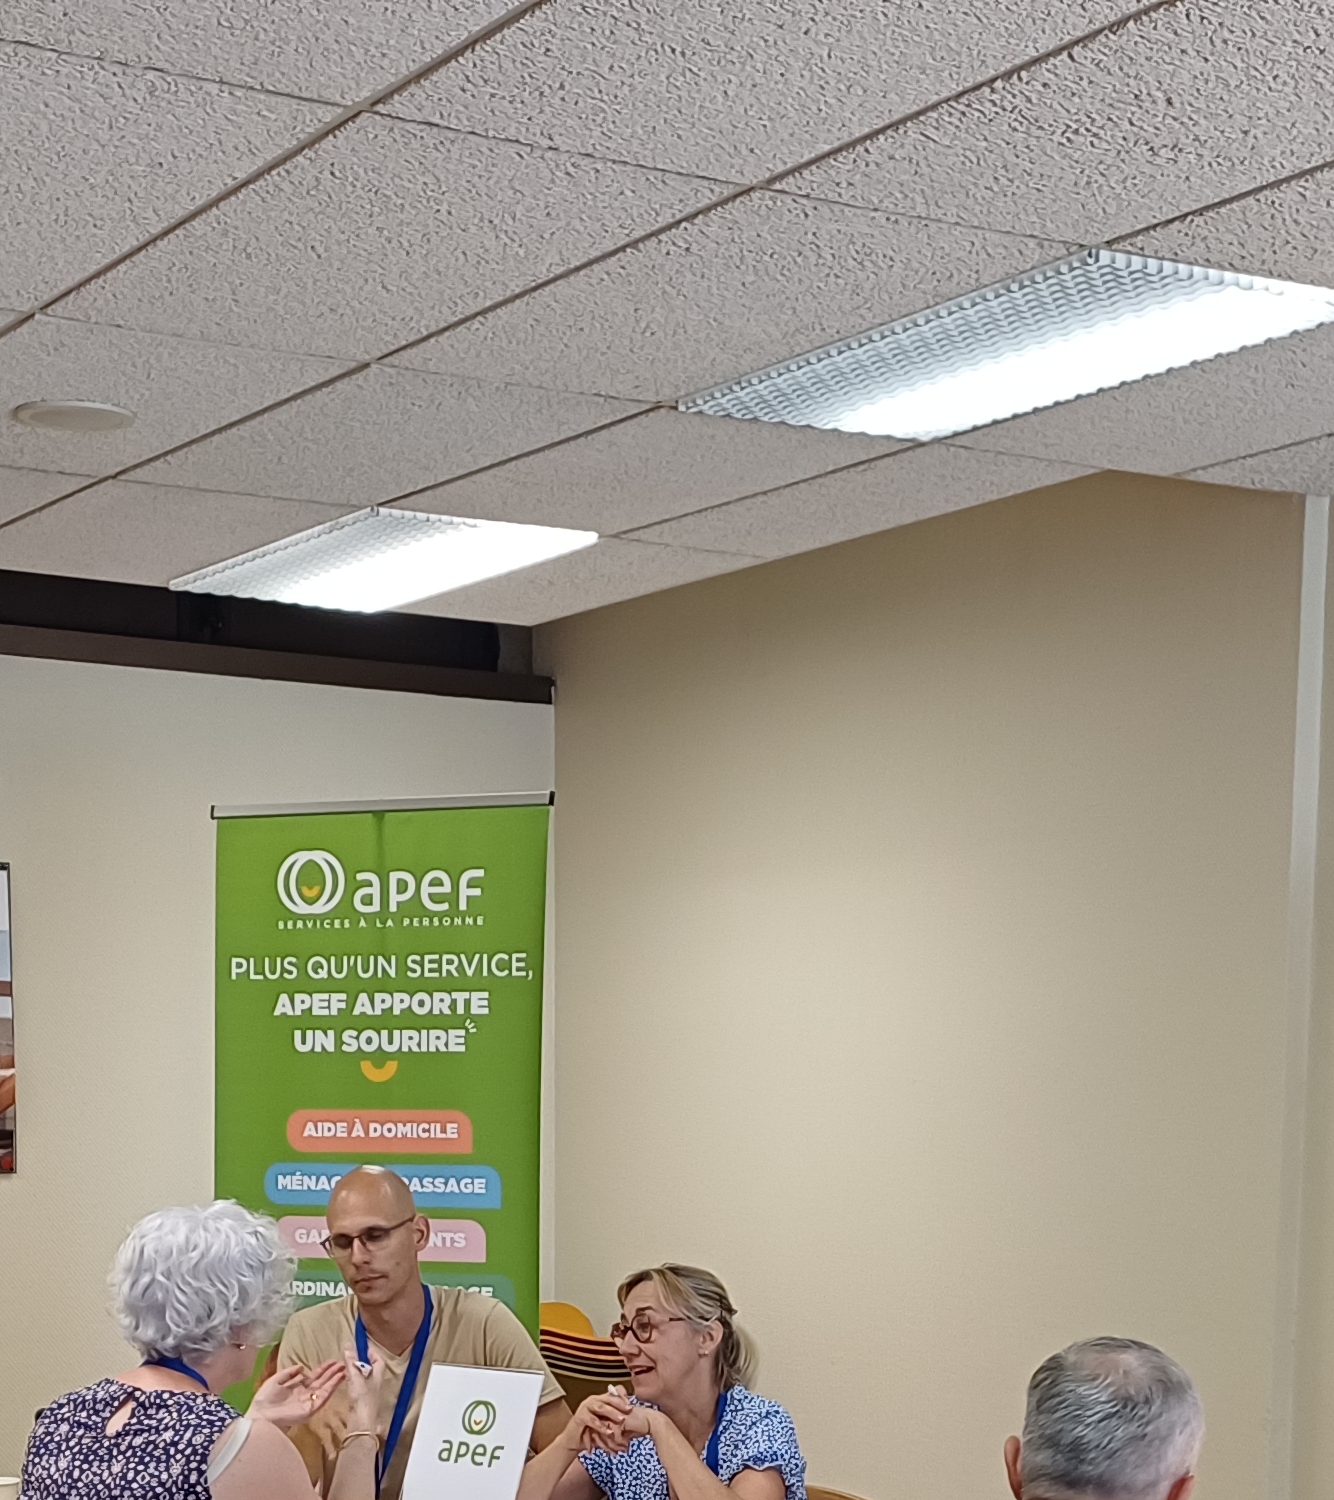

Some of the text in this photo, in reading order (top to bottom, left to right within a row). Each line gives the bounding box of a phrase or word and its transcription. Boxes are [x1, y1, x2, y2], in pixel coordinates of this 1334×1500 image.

[353, 869, 485, 913] apef
[277, 915, 485, 930] SERVICES À LA PERSONNE
[230, 953, 534, 981] PLUS QU'UN SERVICE,
[273, 991, 490, 1016] APEF APPORTE
[293, 1028, 466, 1052] UN SOURIRE
[303, 1118, 459, 1139] AIDE À DOMICILE
[277, 1171, 341, 1191] MÉNA
[437, 1439, 505, 1468] apef
